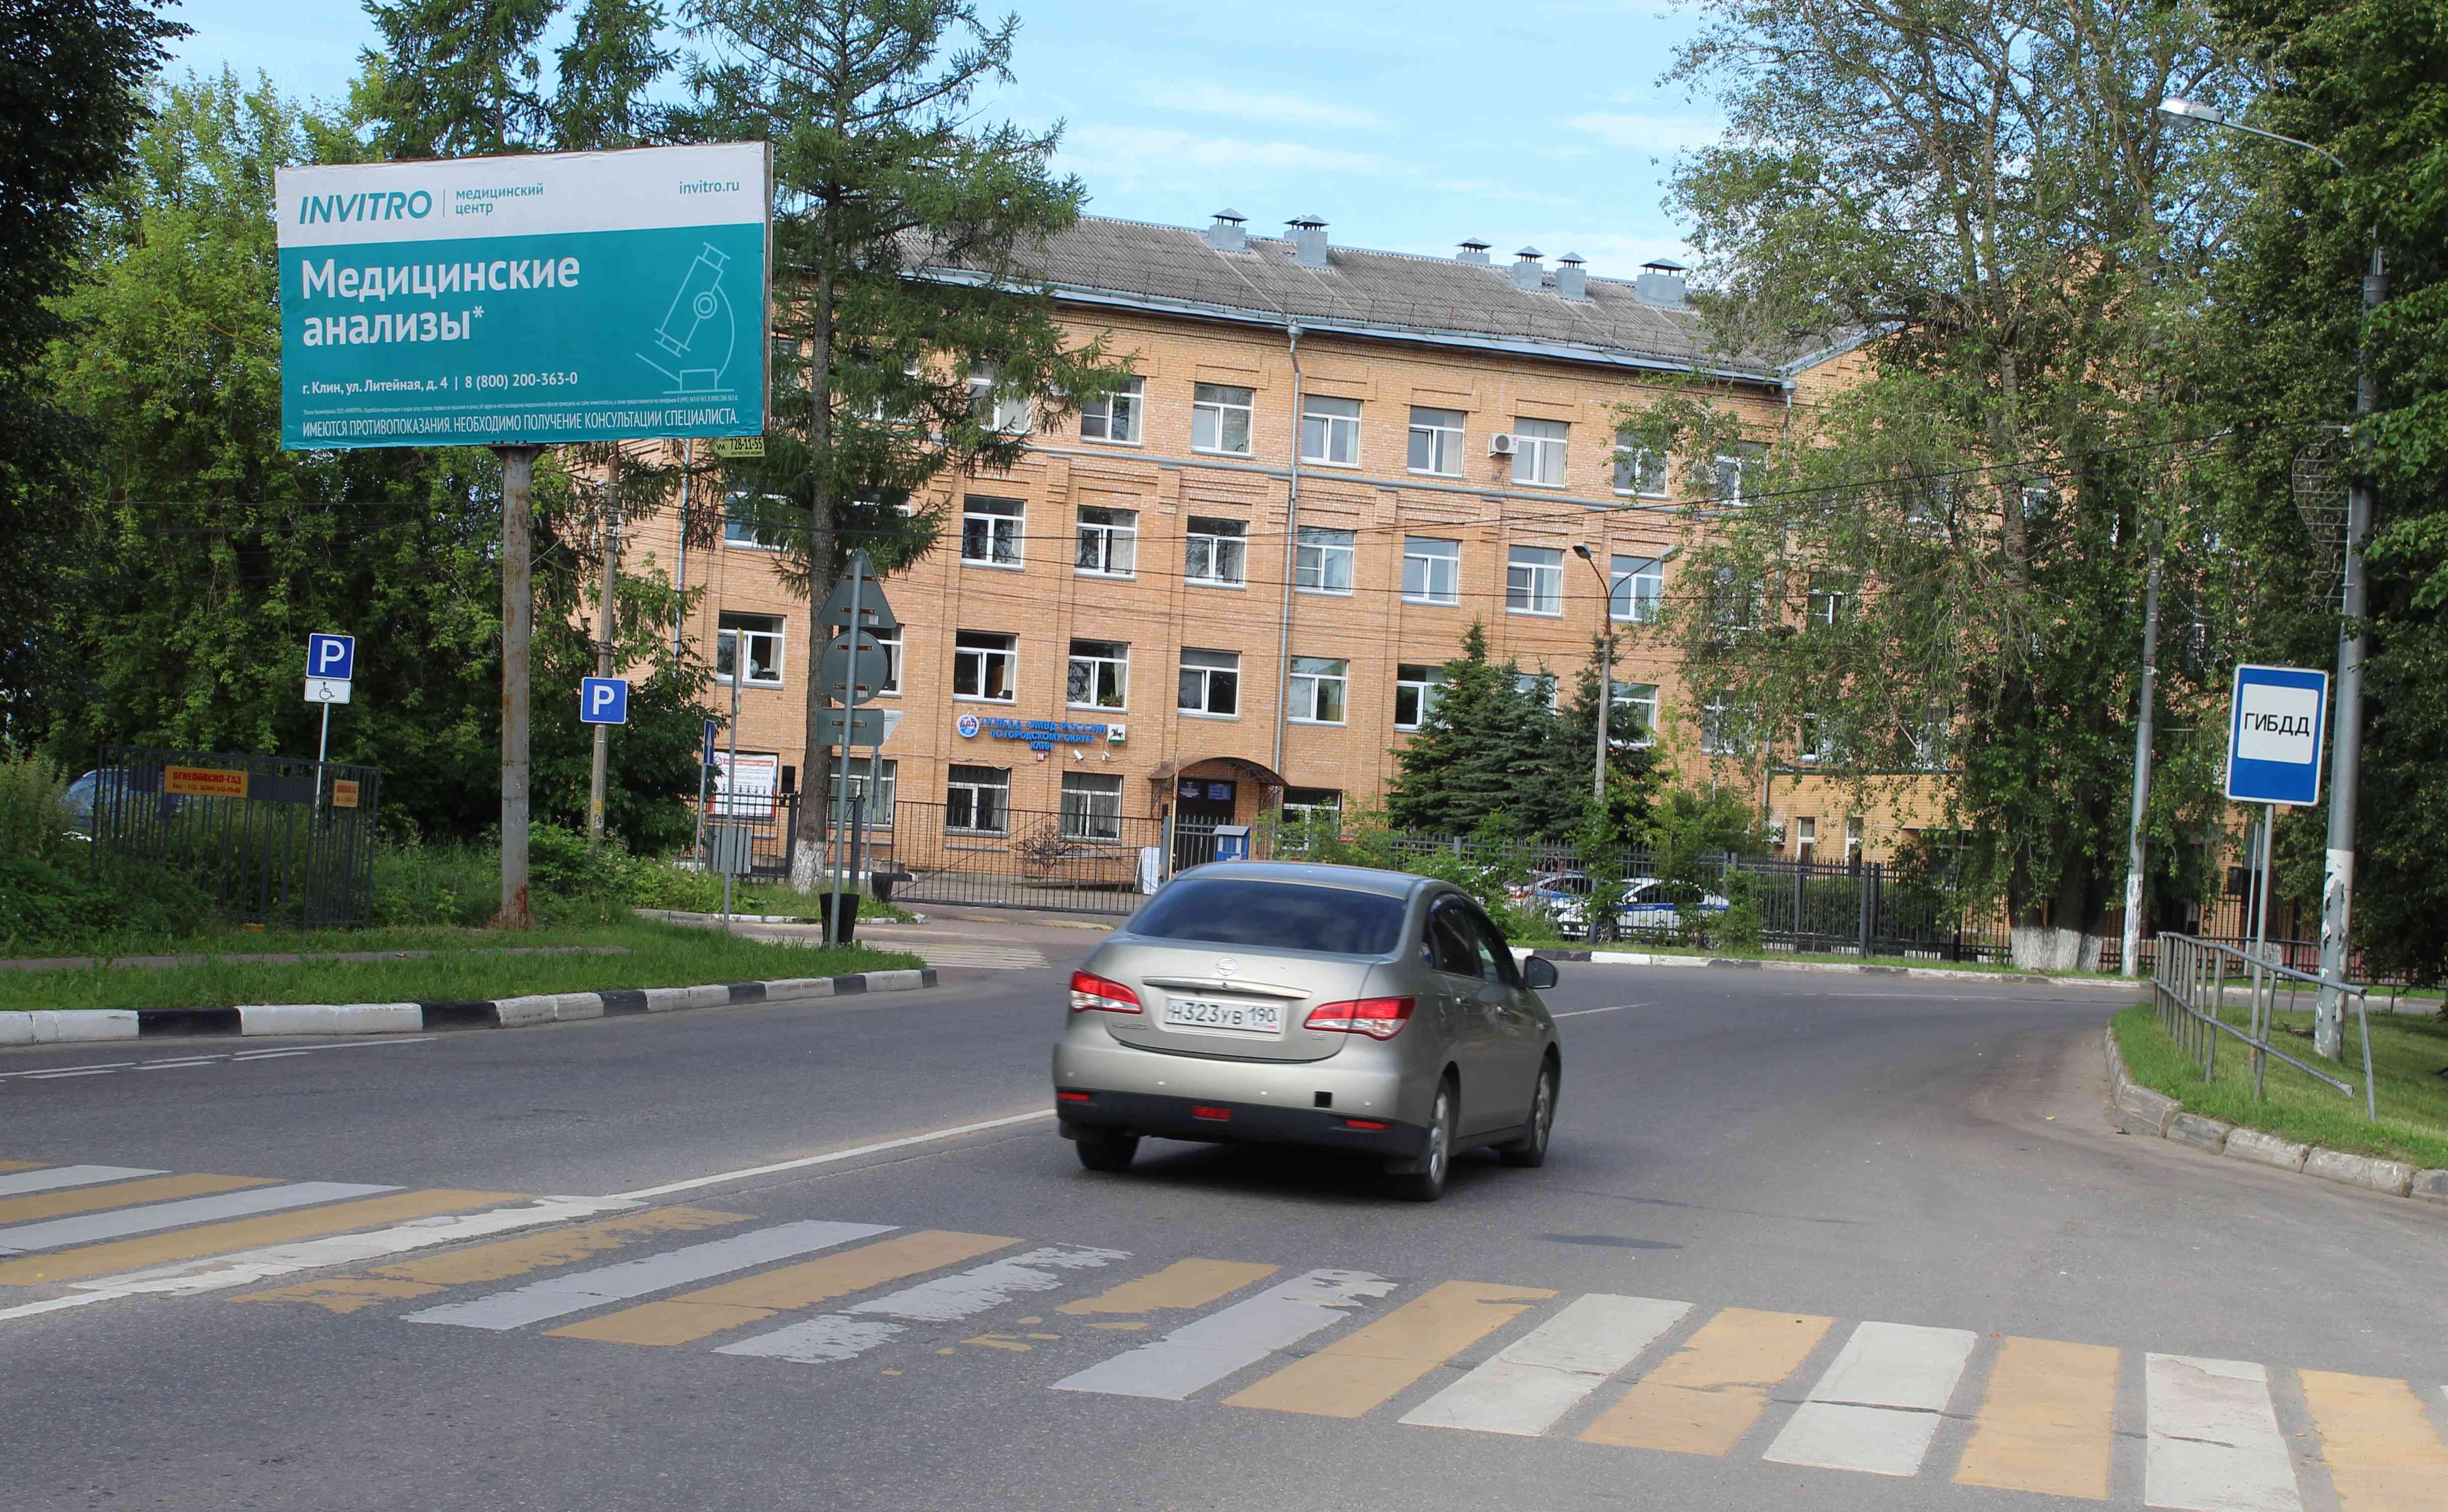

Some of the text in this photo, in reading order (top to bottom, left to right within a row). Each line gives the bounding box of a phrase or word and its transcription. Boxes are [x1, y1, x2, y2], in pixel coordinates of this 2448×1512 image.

[456, 182, 544, 201] медицинский
[679, 179, 740, 195] invitro.ru
[299, 190, 432, 225] INVITRO
[455, 200, 493, 217] центр
[302, 256, 581, 303] Медицинские
[303, 371, 578, 396] г. Клин, ул. Литейная, д. 4 8 (800) 200-363-0
[303, 407, 740, 437] ИМЕЮТСЯ ПРОТИВОПОКАЗАНИЯ. НЕОБХОДИМО ПОЛУЧЕНИЕ КОНСУЛЬТАЦИИ СПЕЦИАЛИСТА.
[730, 438, 763, 450] 728-11-55
[319, 639, 345, 673] P
[593, 685, 615, 715] P
[1005, 730, 1061, 741] ГОРОДСКОМУ
[2244, 713, 2310, 737] ГИБДД
[1030, 740, 1054, 750] КЛИН
[1248, 1007, 1277, 1022] 190
